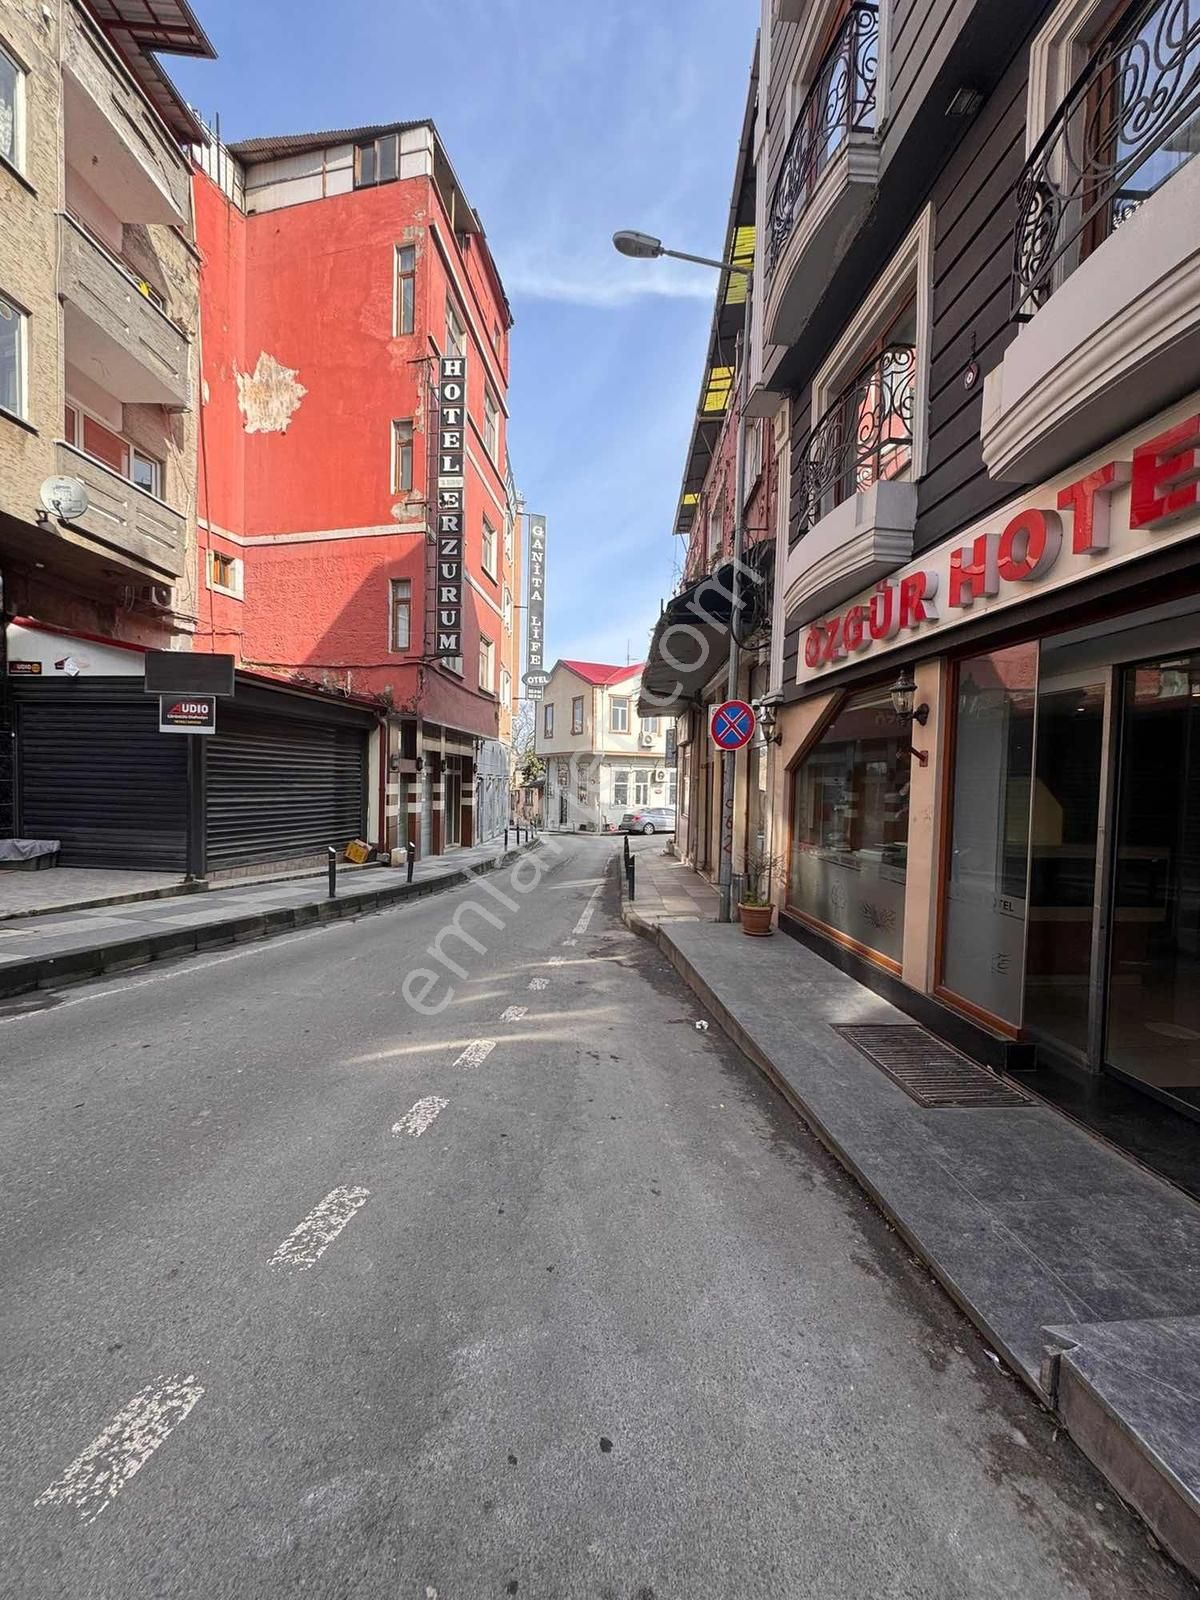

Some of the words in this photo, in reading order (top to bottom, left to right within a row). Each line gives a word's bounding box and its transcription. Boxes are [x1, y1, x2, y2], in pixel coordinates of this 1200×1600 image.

[442, 359, 463, 473] HOTEL
[438, 491, 460, 652] ERZURUM
[530, 525, 545, 601] GANİTA
[529, 615, 542, 665] LİFE
[804, 569, 933, 668] ÖZGÜR
[527, 675, 549, 684] OTEL
